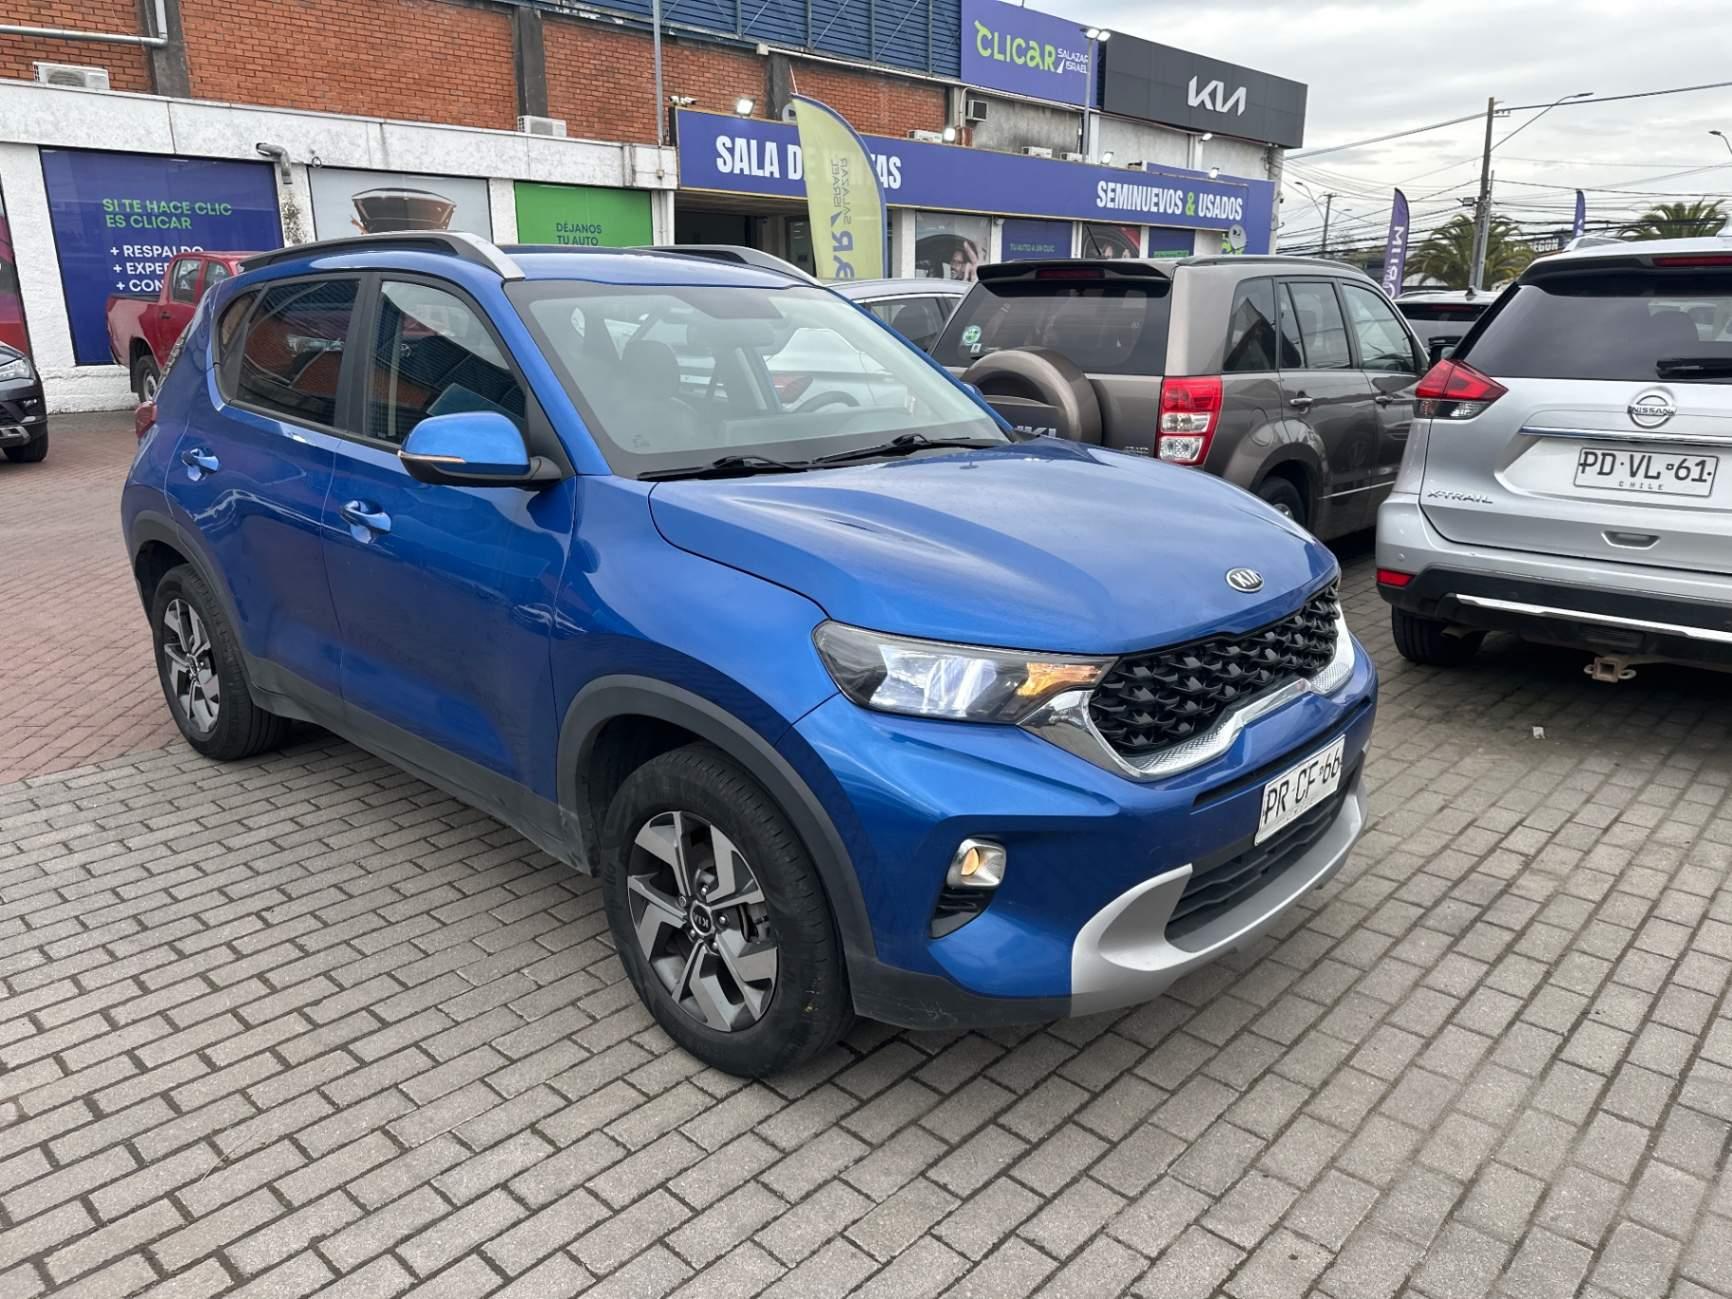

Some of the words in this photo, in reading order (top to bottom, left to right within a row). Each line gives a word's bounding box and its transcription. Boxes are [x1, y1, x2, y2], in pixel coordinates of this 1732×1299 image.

[1187, 75, 1247, 117] KIA
[715, 135, 780, 179] SALA
[787, 143, 808, 181] D
[102, 198, 119, 212] SI
[121, 199, 142, 212] TE
[146, 200, 191, 214] HACE
[194, 202, 232, 216] CLIC
[1096, 180, 1183, 215] SEMINUEVOS
[1185, 191, 1196, 216] &
[1198, 192, 1243, 221] USADOS
[106, 214, 127, 228] ES
[130, 215, 192, 229] CLICAR
[557, 235, 570, 245] TU
[572, 236, 599, 247] AUTO
[1231, 570, 1260, 588] KIA
